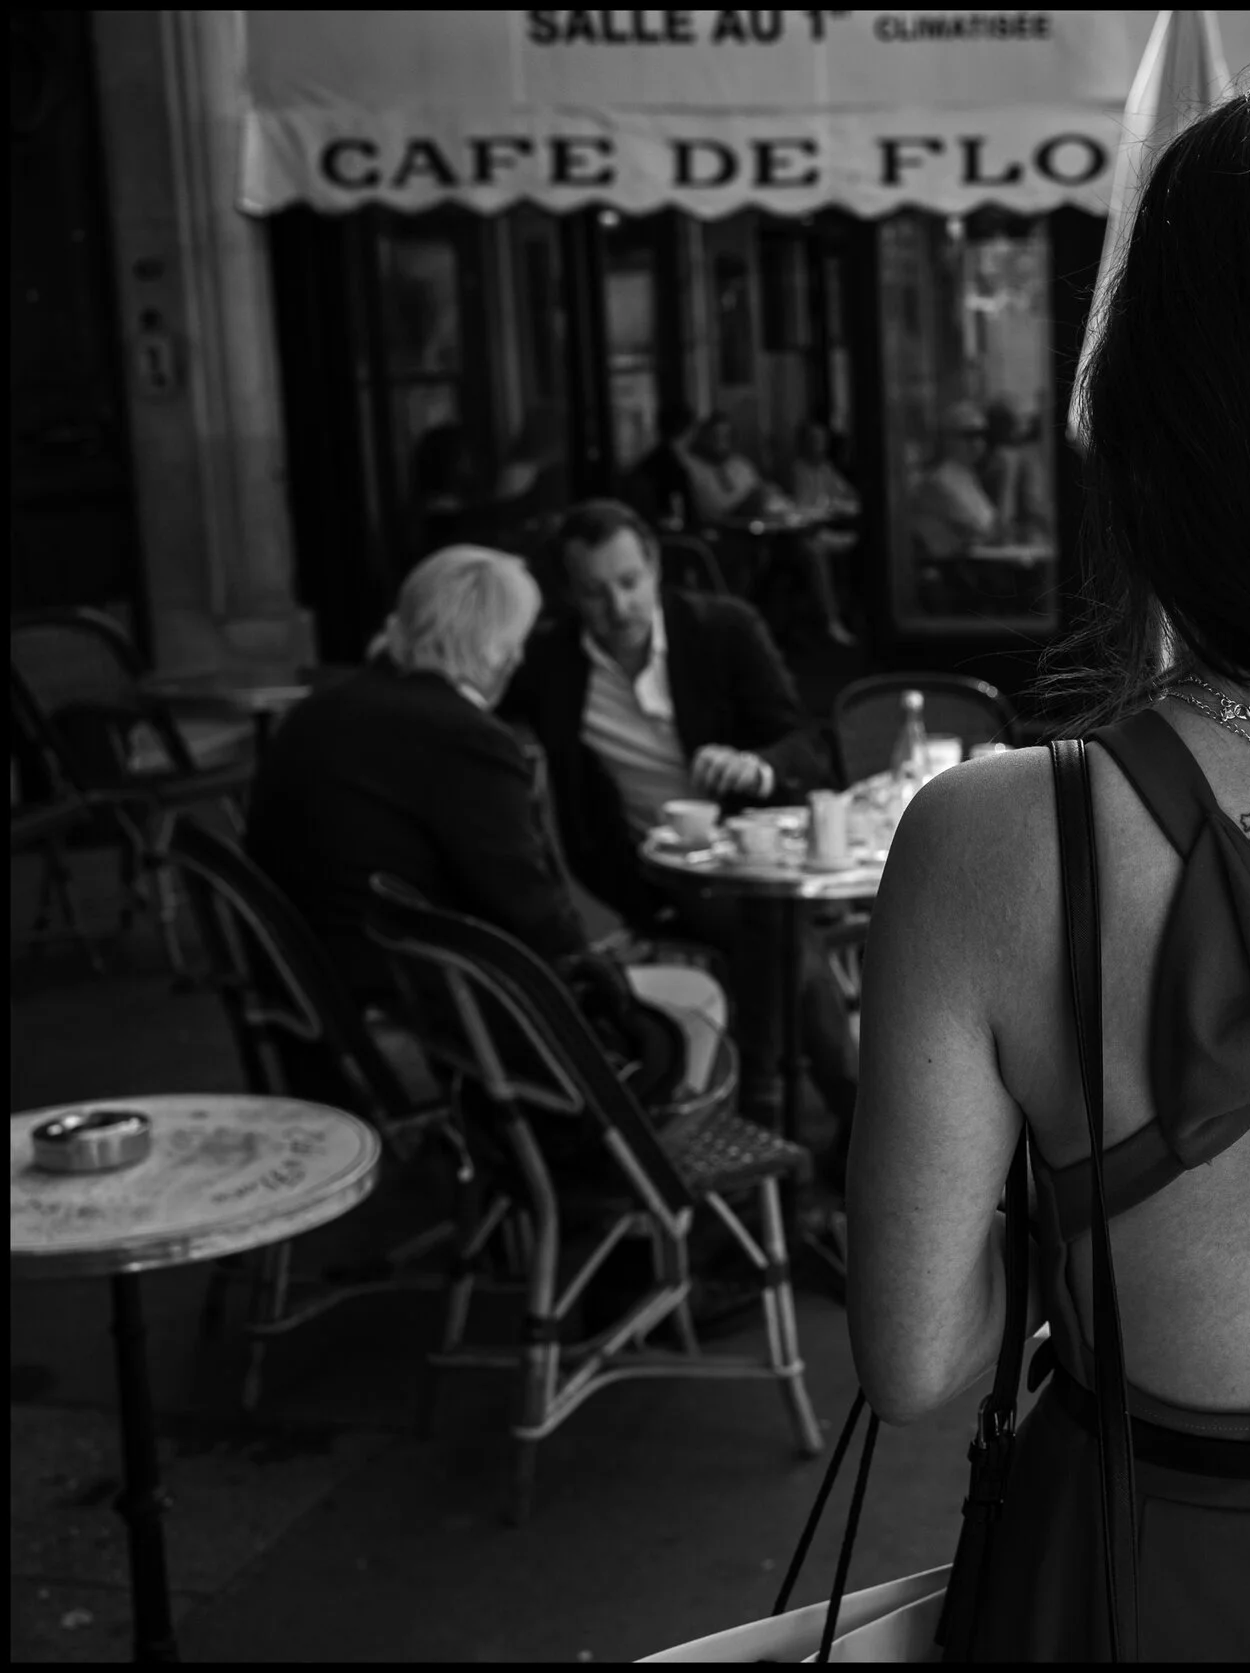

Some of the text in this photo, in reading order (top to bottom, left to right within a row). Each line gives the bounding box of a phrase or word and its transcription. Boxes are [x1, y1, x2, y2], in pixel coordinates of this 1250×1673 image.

[527, 10, 697, 46] SALLE
[709, 10, 785, 45] AU
[319, 132, 1109, 191] CAFE DE FLO
